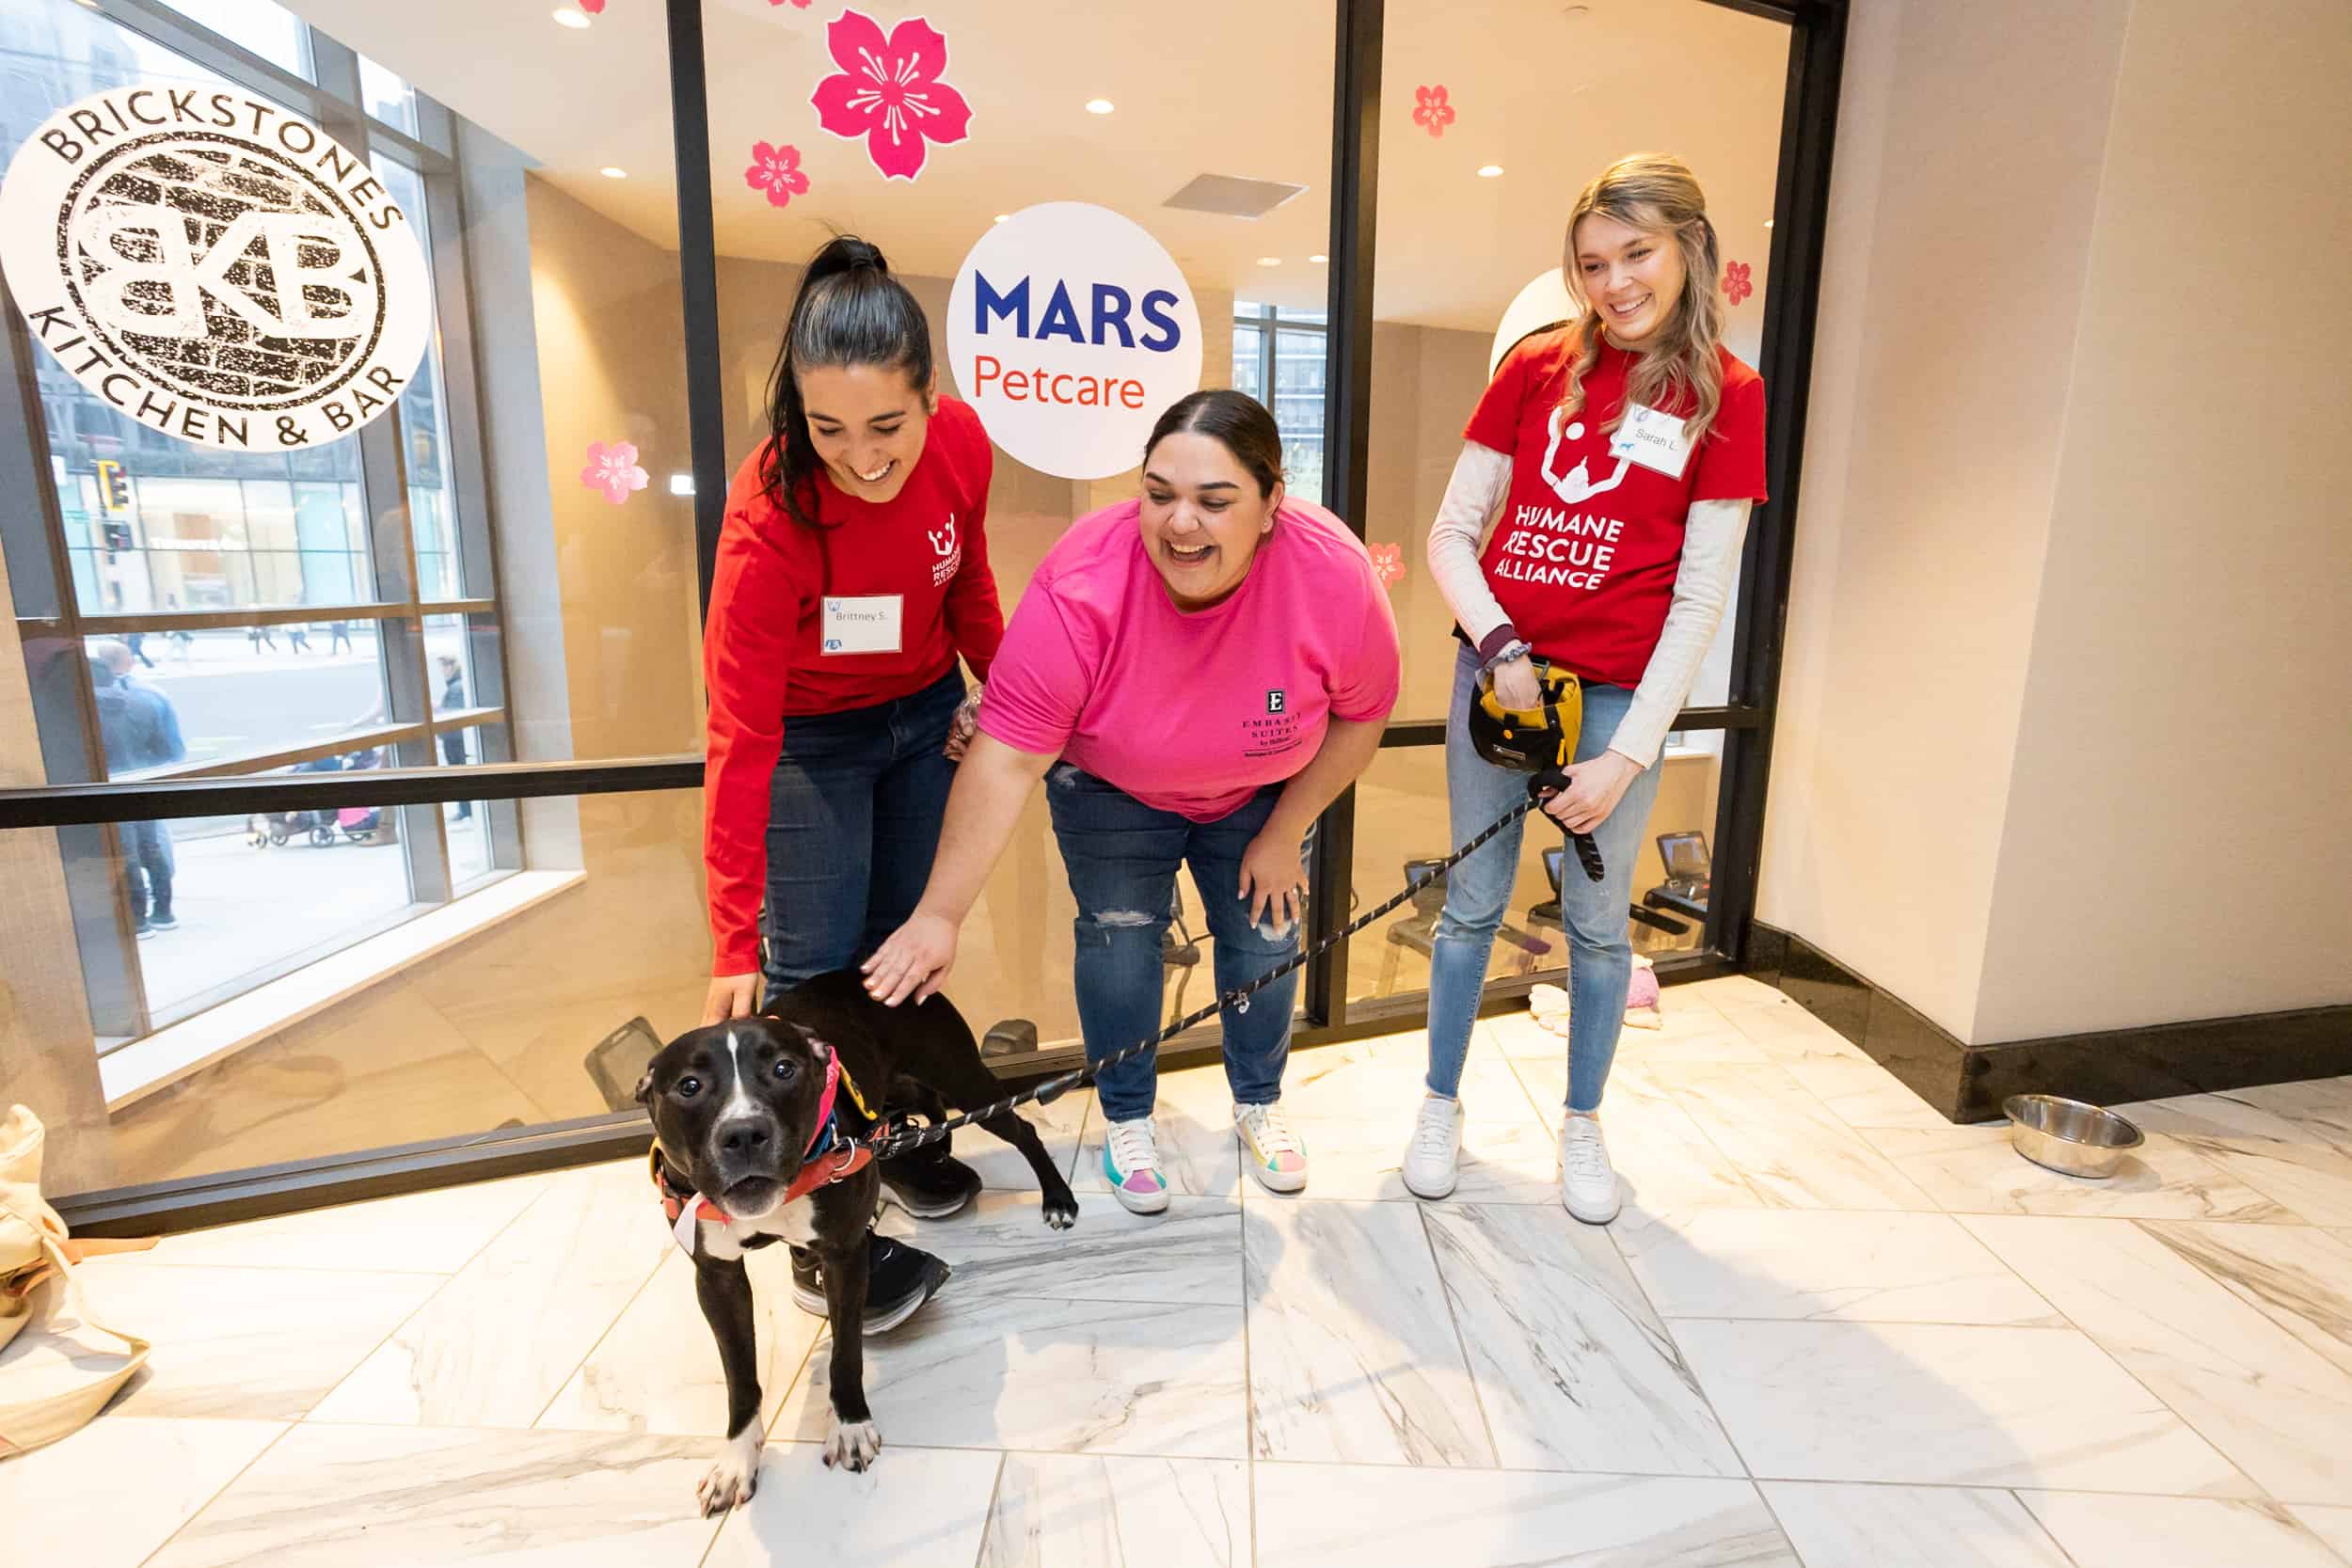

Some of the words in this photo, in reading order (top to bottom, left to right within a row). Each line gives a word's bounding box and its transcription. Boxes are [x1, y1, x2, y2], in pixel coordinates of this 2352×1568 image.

[40, 89, 404, 230] BRICKSTONES
[975, 269, 1181, 353] MARS
[29, 306, 248, 447] KITCHEN
[276, 415, 309, 446] &
[321, 365, 404, 432] BAR
[975, 355, 1145, 409] Petcare
[1635, 429, 1667, 447] Sarah
[1515, 504, 1625, 543] HUMANE
[1502, 531, 1615, 571] RESCUE
[1494, 558, 1605, 591] ALLIANCE
[835, 611, 877, 622] Brittney
[1270, 692, 1281, 710] E
